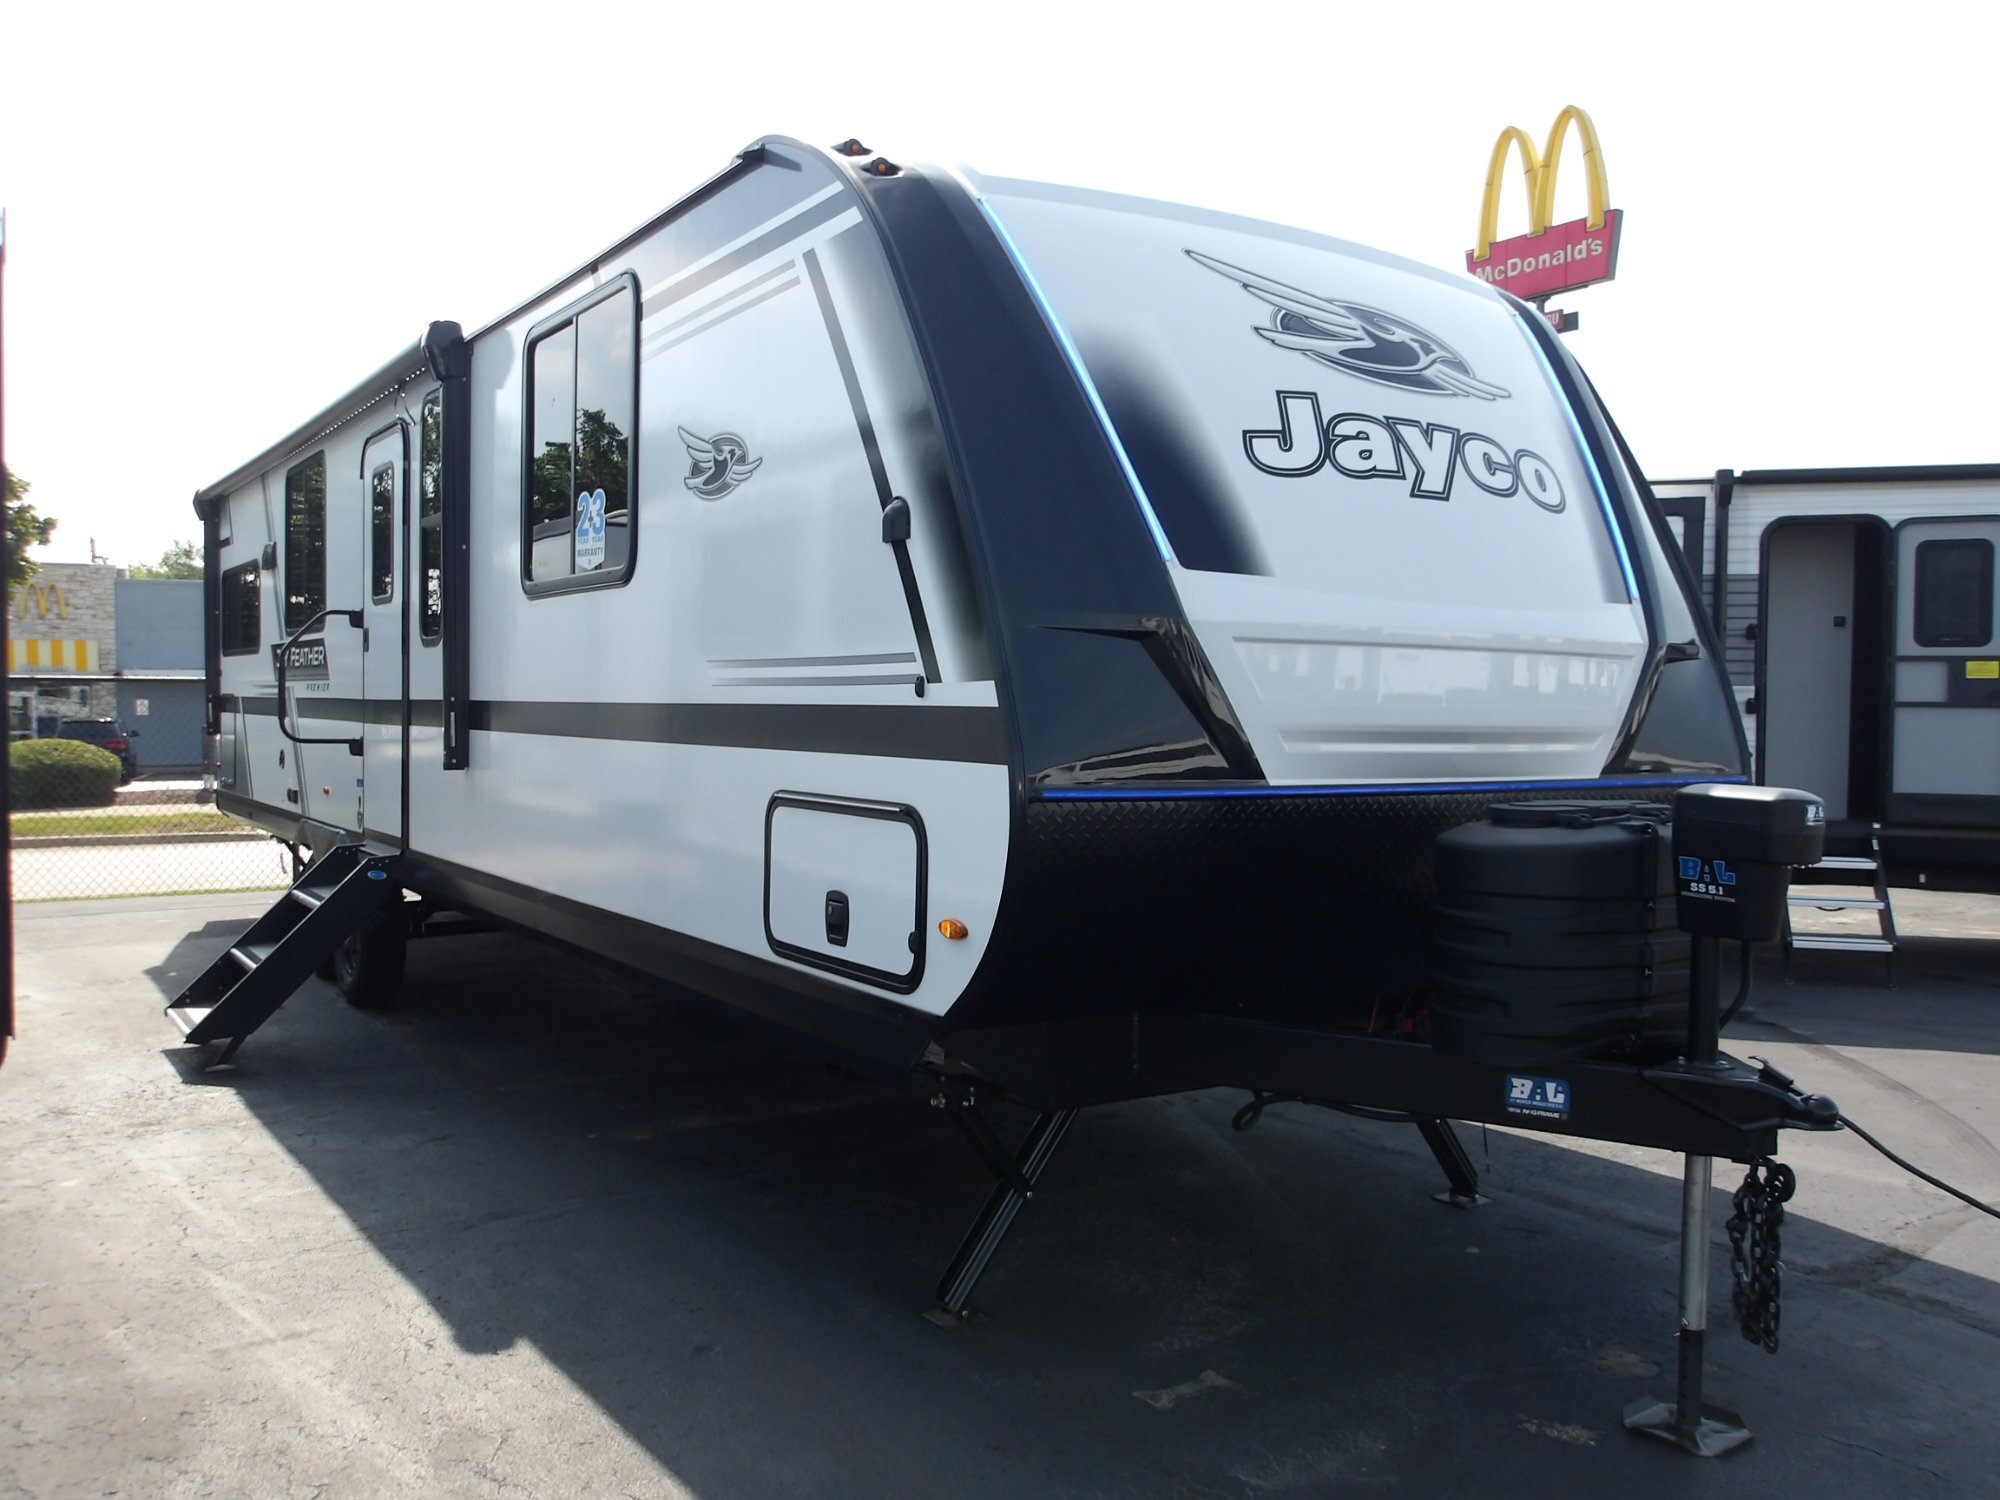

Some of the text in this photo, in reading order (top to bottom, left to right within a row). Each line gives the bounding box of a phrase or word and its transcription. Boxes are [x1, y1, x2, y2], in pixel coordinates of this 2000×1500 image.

[1475, 239, 1603, 283] McDonald's
[1242, 389, 1567, 515] Jayco
[577, 546, 604, 558] WARRANTY
[290, 646, 325, 668] FEATHER
[1678, 855, 1736, 886] BAL
[1510, 1077, 1565, 1105] BAL
